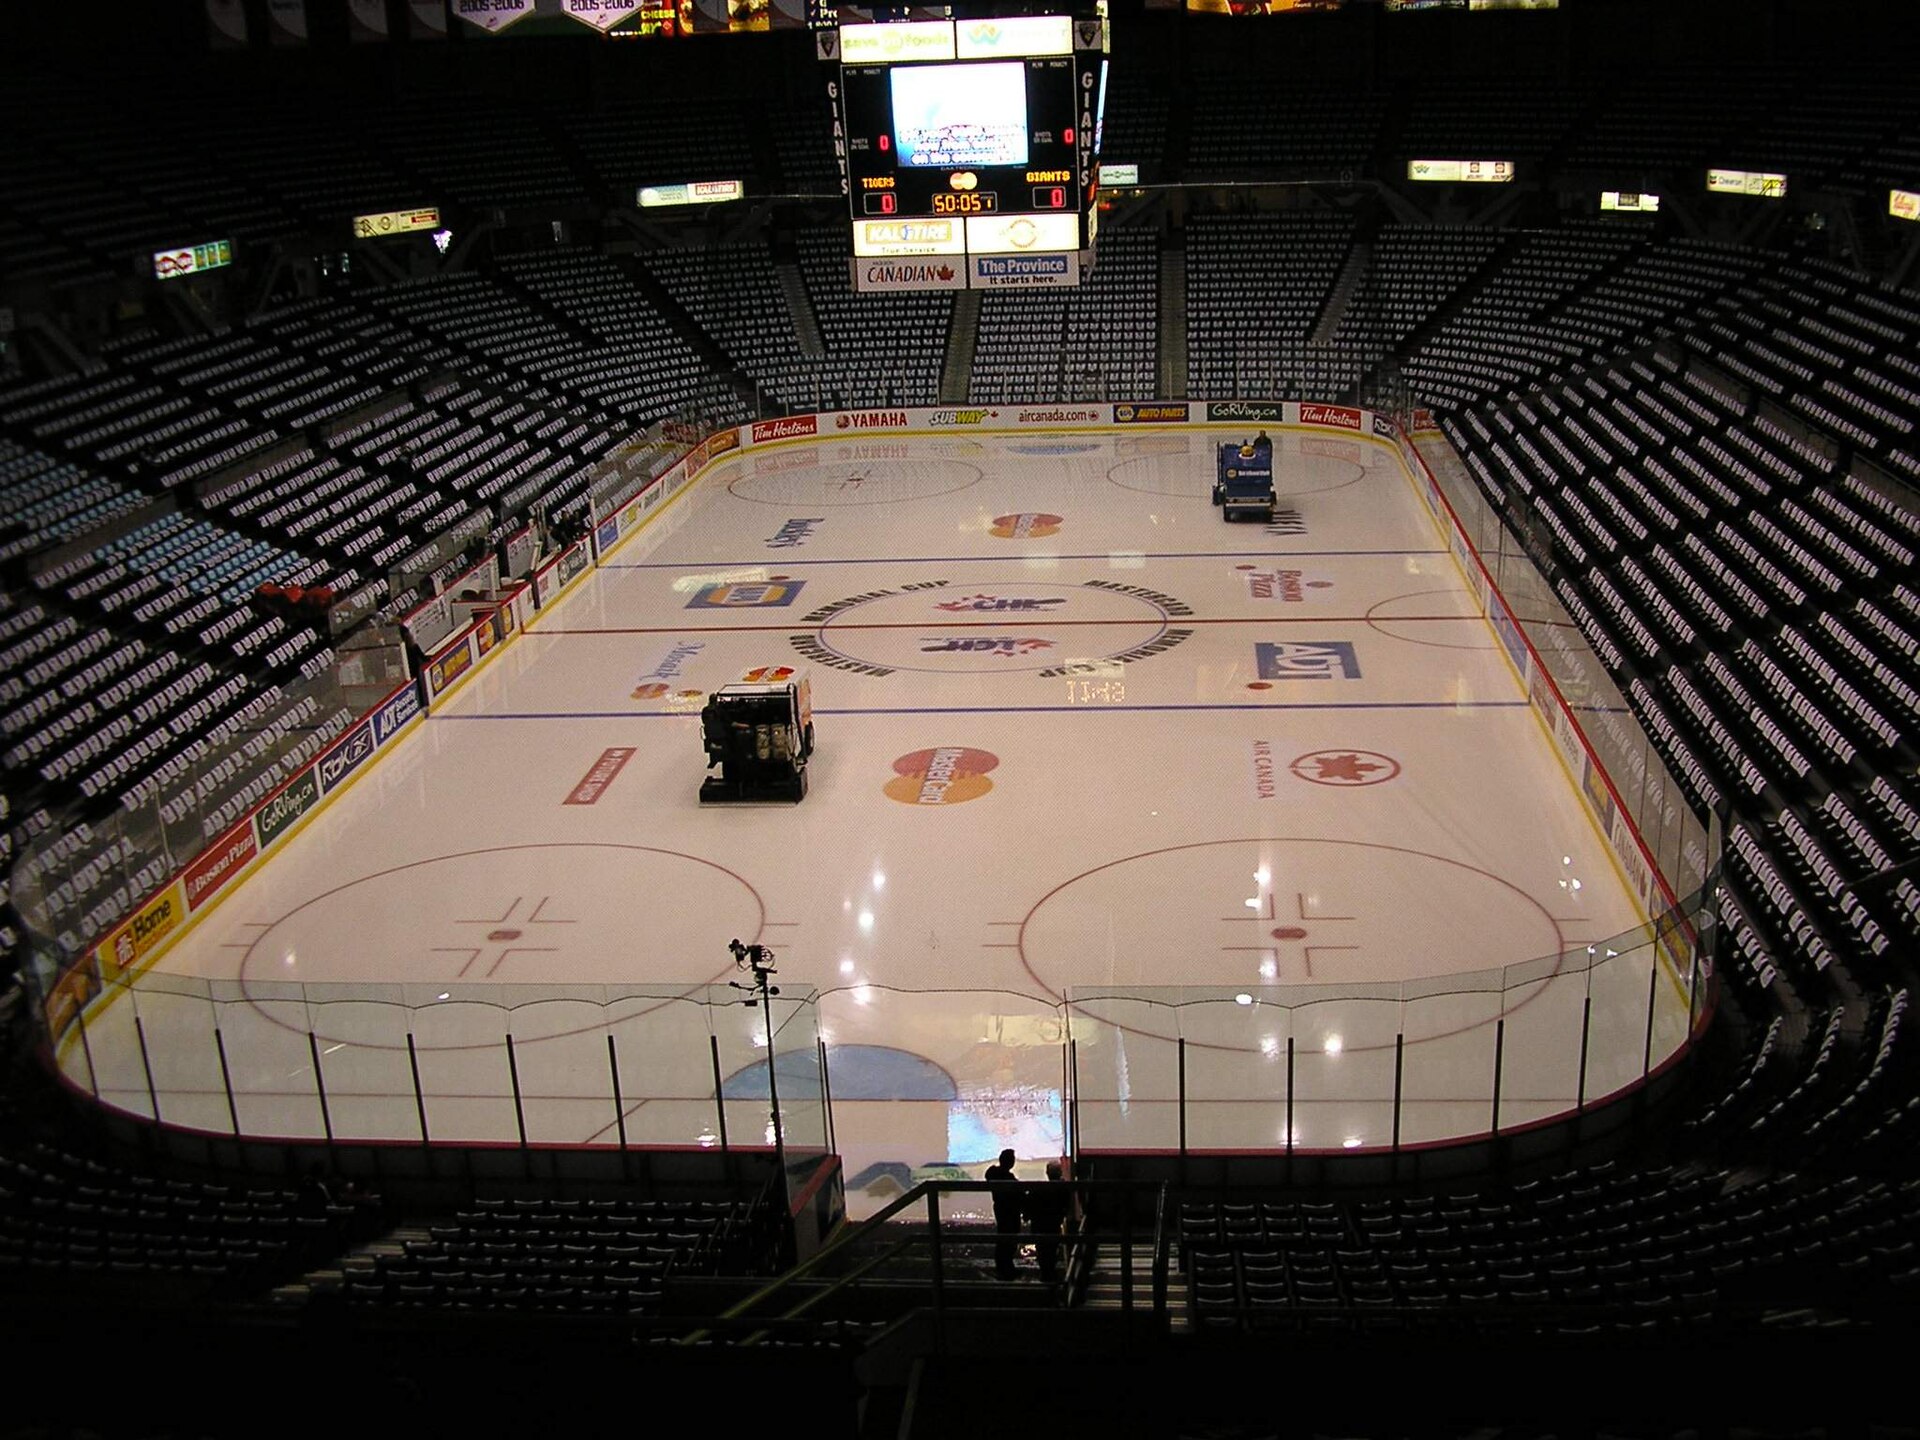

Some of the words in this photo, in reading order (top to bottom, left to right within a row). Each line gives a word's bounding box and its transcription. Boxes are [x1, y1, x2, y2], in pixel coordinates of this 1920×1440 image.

[1064, 129, 1074, 143] 0
[1081, 72, 1094, 187] GIANTS
[827, 82, 849, 195] GIANTS
[880, 135, 889, 150] 0
[862, 177, 895, 188] TIGERS
[1026, 171, 1070, 183] GIANTS
[882, 195, 893, 212] 0
[934, 194, 982, 213] 50:05
[1051, 190, 1062, 207] 0
[867, 265, 937, 283] CANADIAN
[981, 259, 1007, 274] The
[1008, 257, 1065, 273] Province
[1000, 276, 1030, 285] starts
[1032, 275, 1058, 284] here.
[851, 412, 908, 428] YAMAHA
[929, 409, 990, 425] SUBWAY
[1018, 411, 1088, 422] aircanada.com
[1137, 408, 1160, 418] AUTO
[1161, 407, 1186, 417] PARTS
[1211, 403, 1278, 420] GoRVing.ca
[1302, 407, 1321, 421] Tim
[1321, 410, 1360, 428] Hortons
[753, 424, 773, 442] Tim
[773, 420, 816, 438] Hortons
[380, 705, 397, 738] ADT
[920, 747, 964, 804] MasterCard
[260, 782, 315, 832] GoRVing.ca
[133, 898, 172, 942] Home
